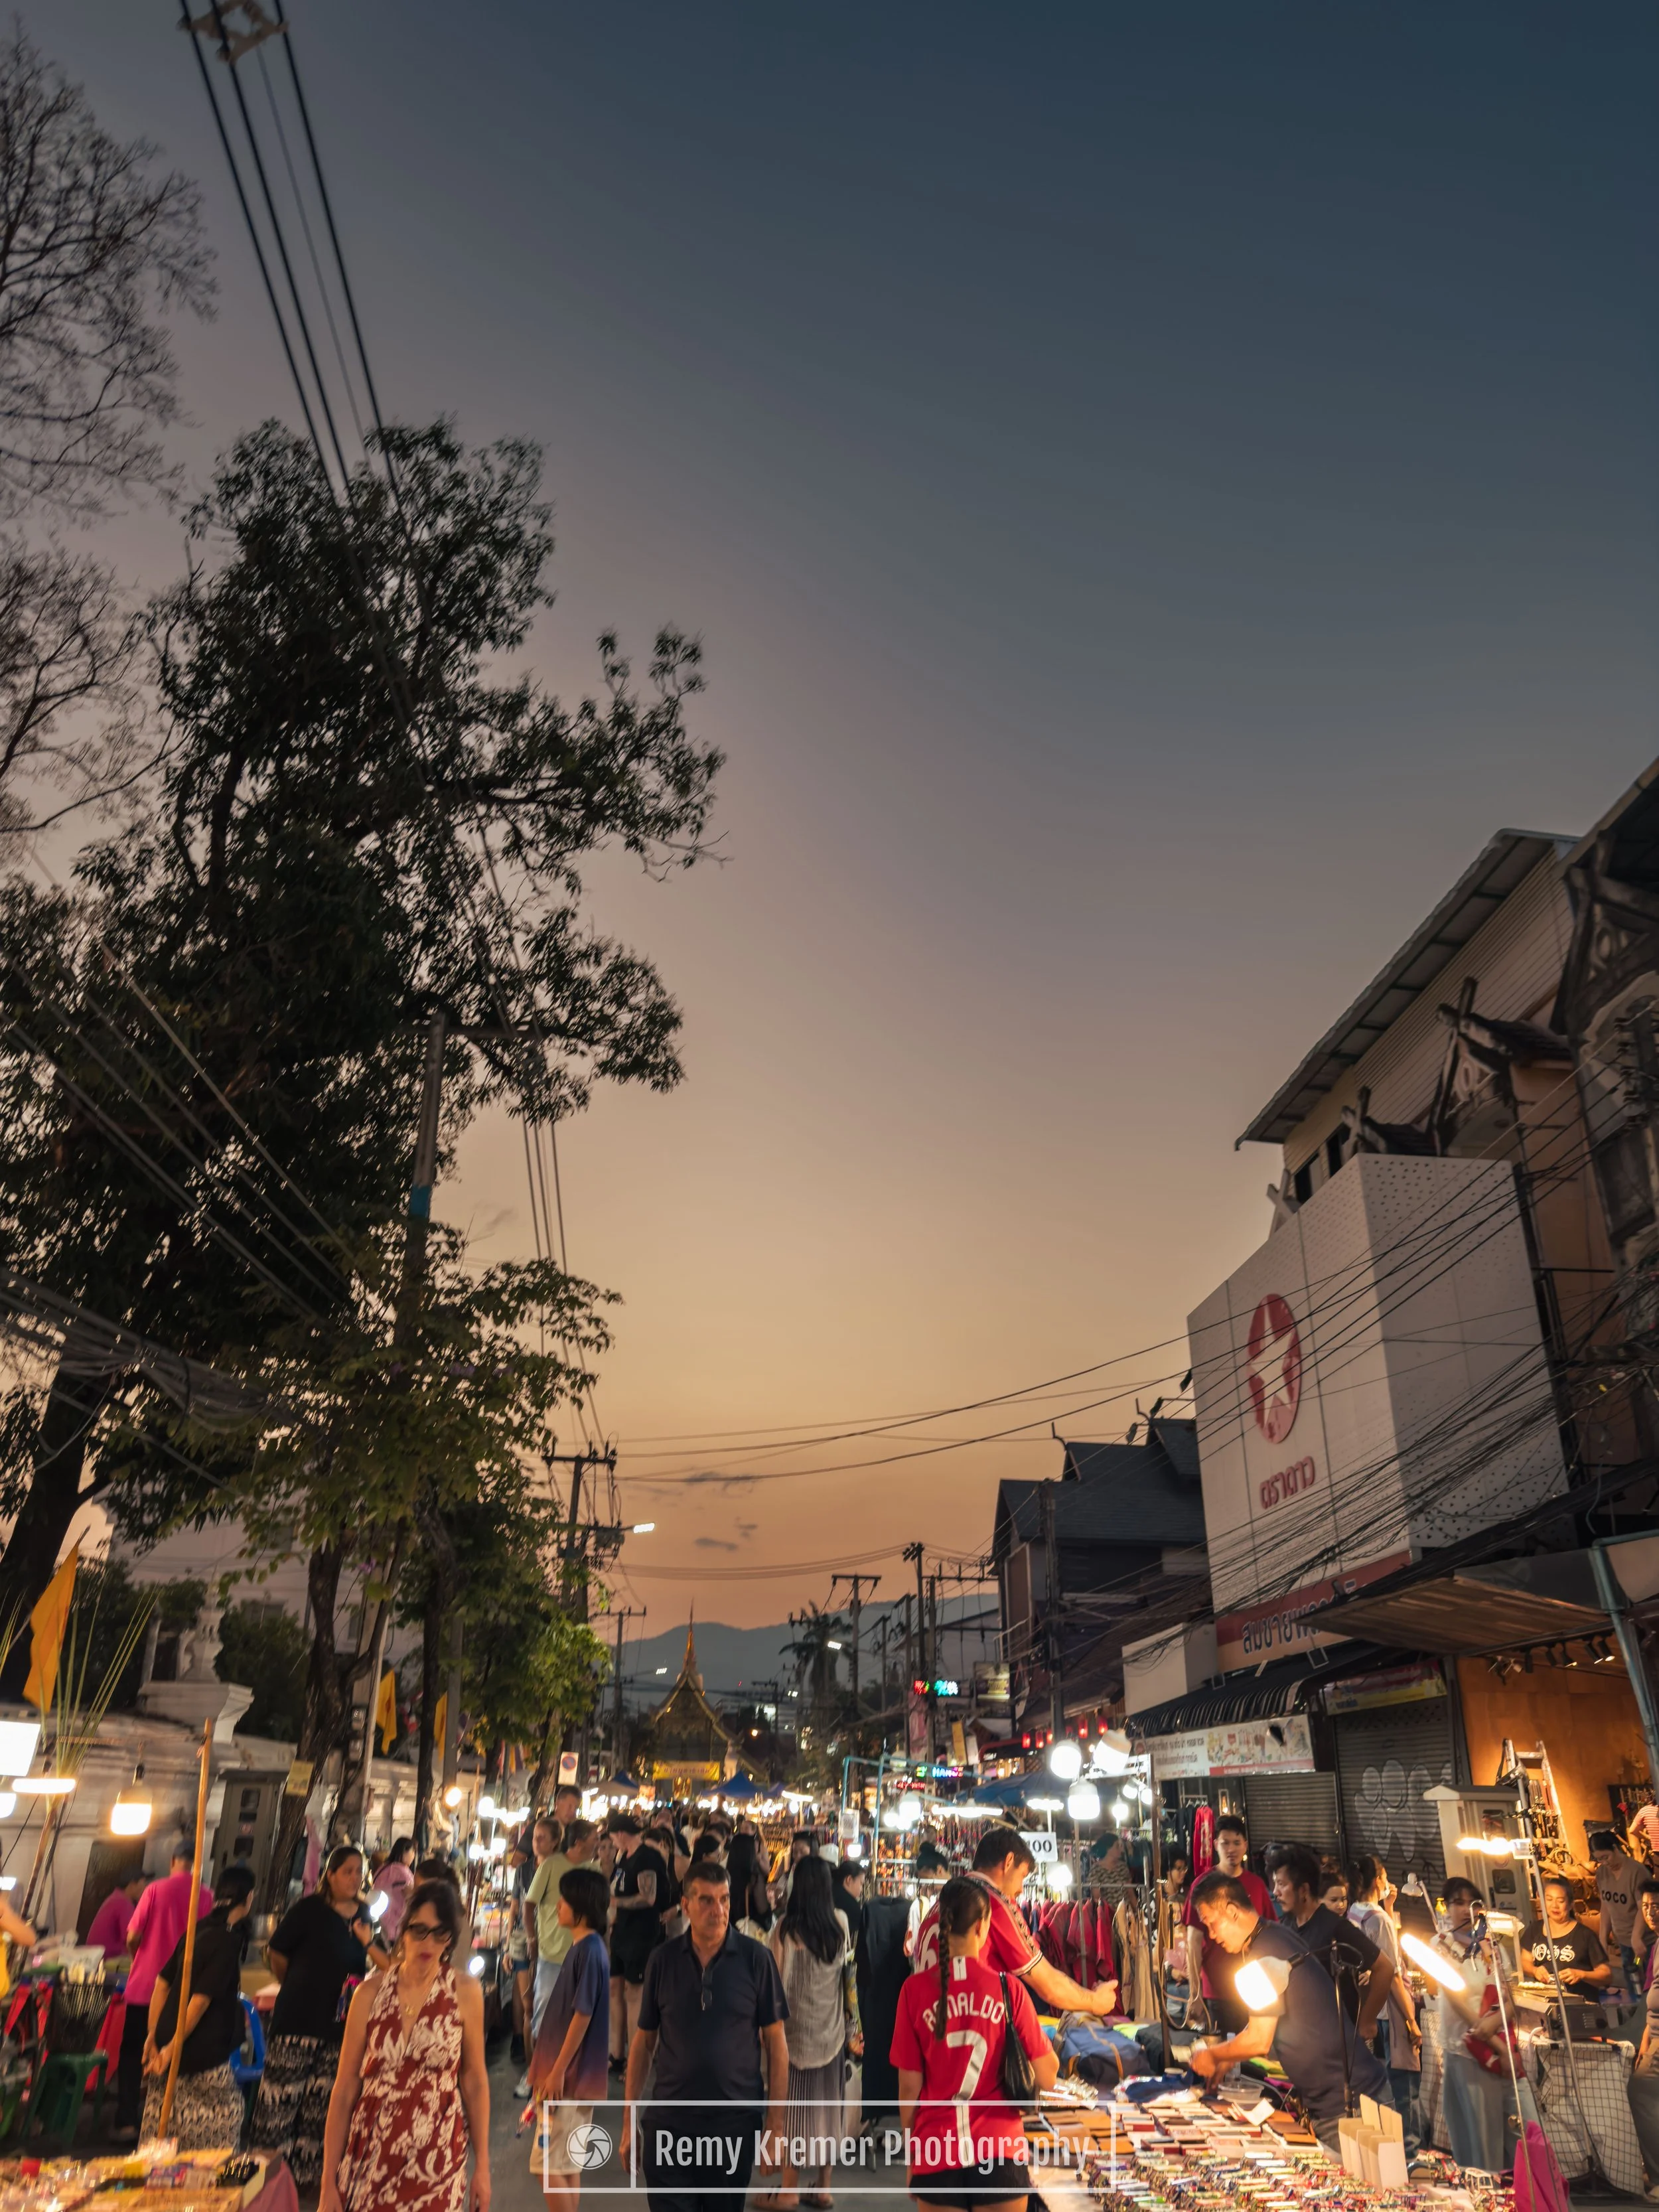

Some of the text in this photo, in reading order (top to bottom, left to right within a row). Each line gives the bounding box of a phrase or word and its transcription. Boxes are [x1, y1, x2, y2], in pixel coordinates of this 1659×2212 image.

[1260, 1455, 1315, 1509] ตราดาว
[922, 1992, 1005, 2032] RNALDO
[946, 2029, 987, 2104] 7
